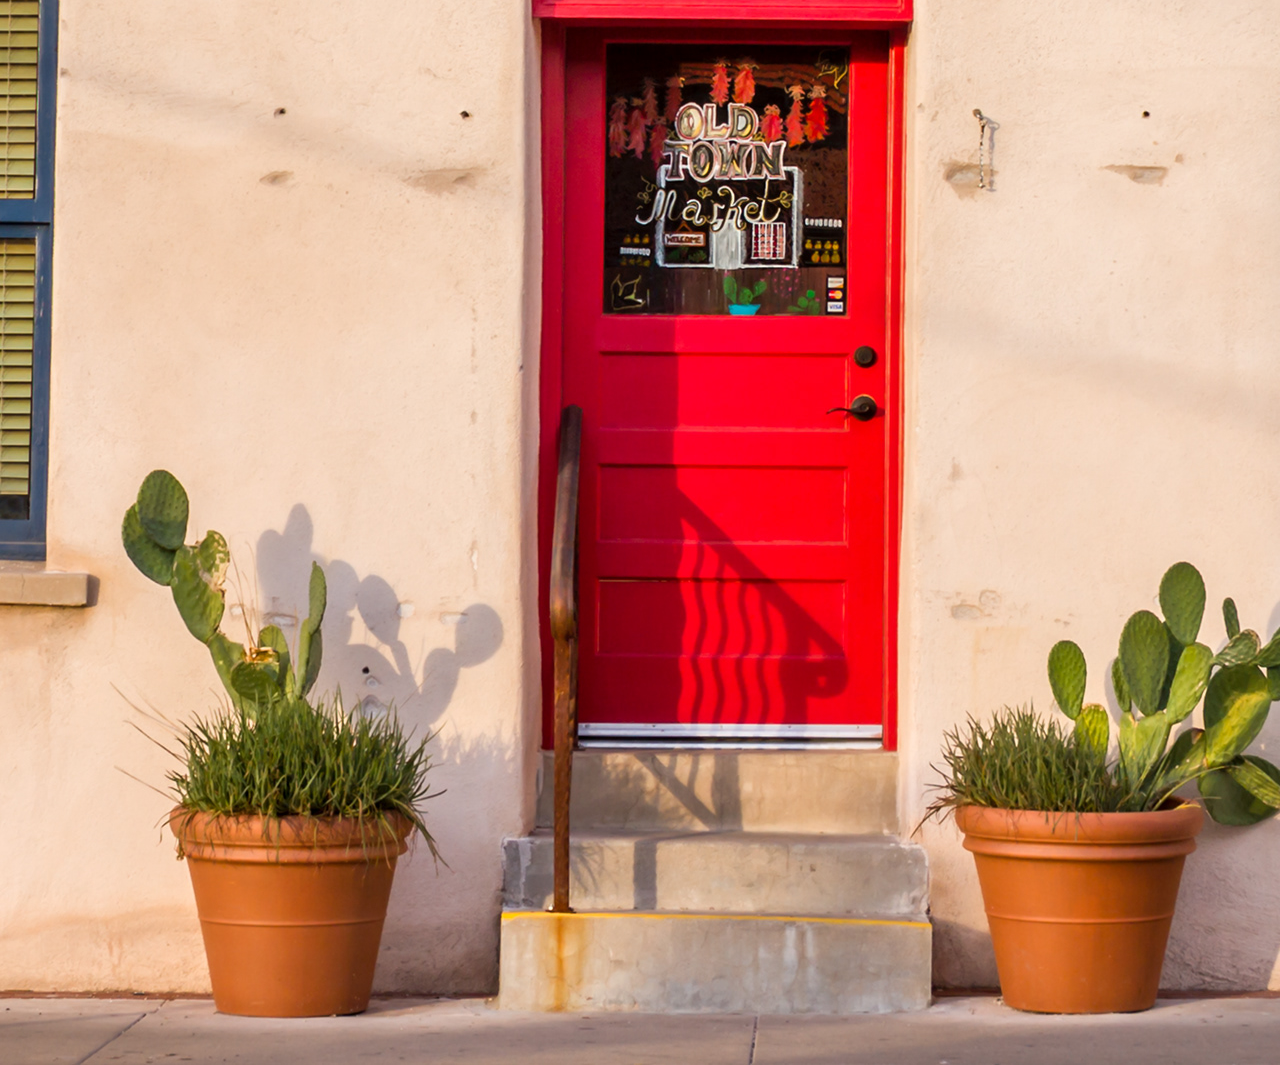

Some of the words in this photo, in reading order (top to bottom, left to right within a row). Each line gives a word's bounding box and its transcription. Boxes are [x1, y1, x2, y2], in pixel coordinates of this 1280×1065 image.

[675, 102, 759, 141] OLD
[663, 140, 787, 182] TOWN
[635, 179, 781, 232] Market
[666, 235, 703, 244] WELCOME
